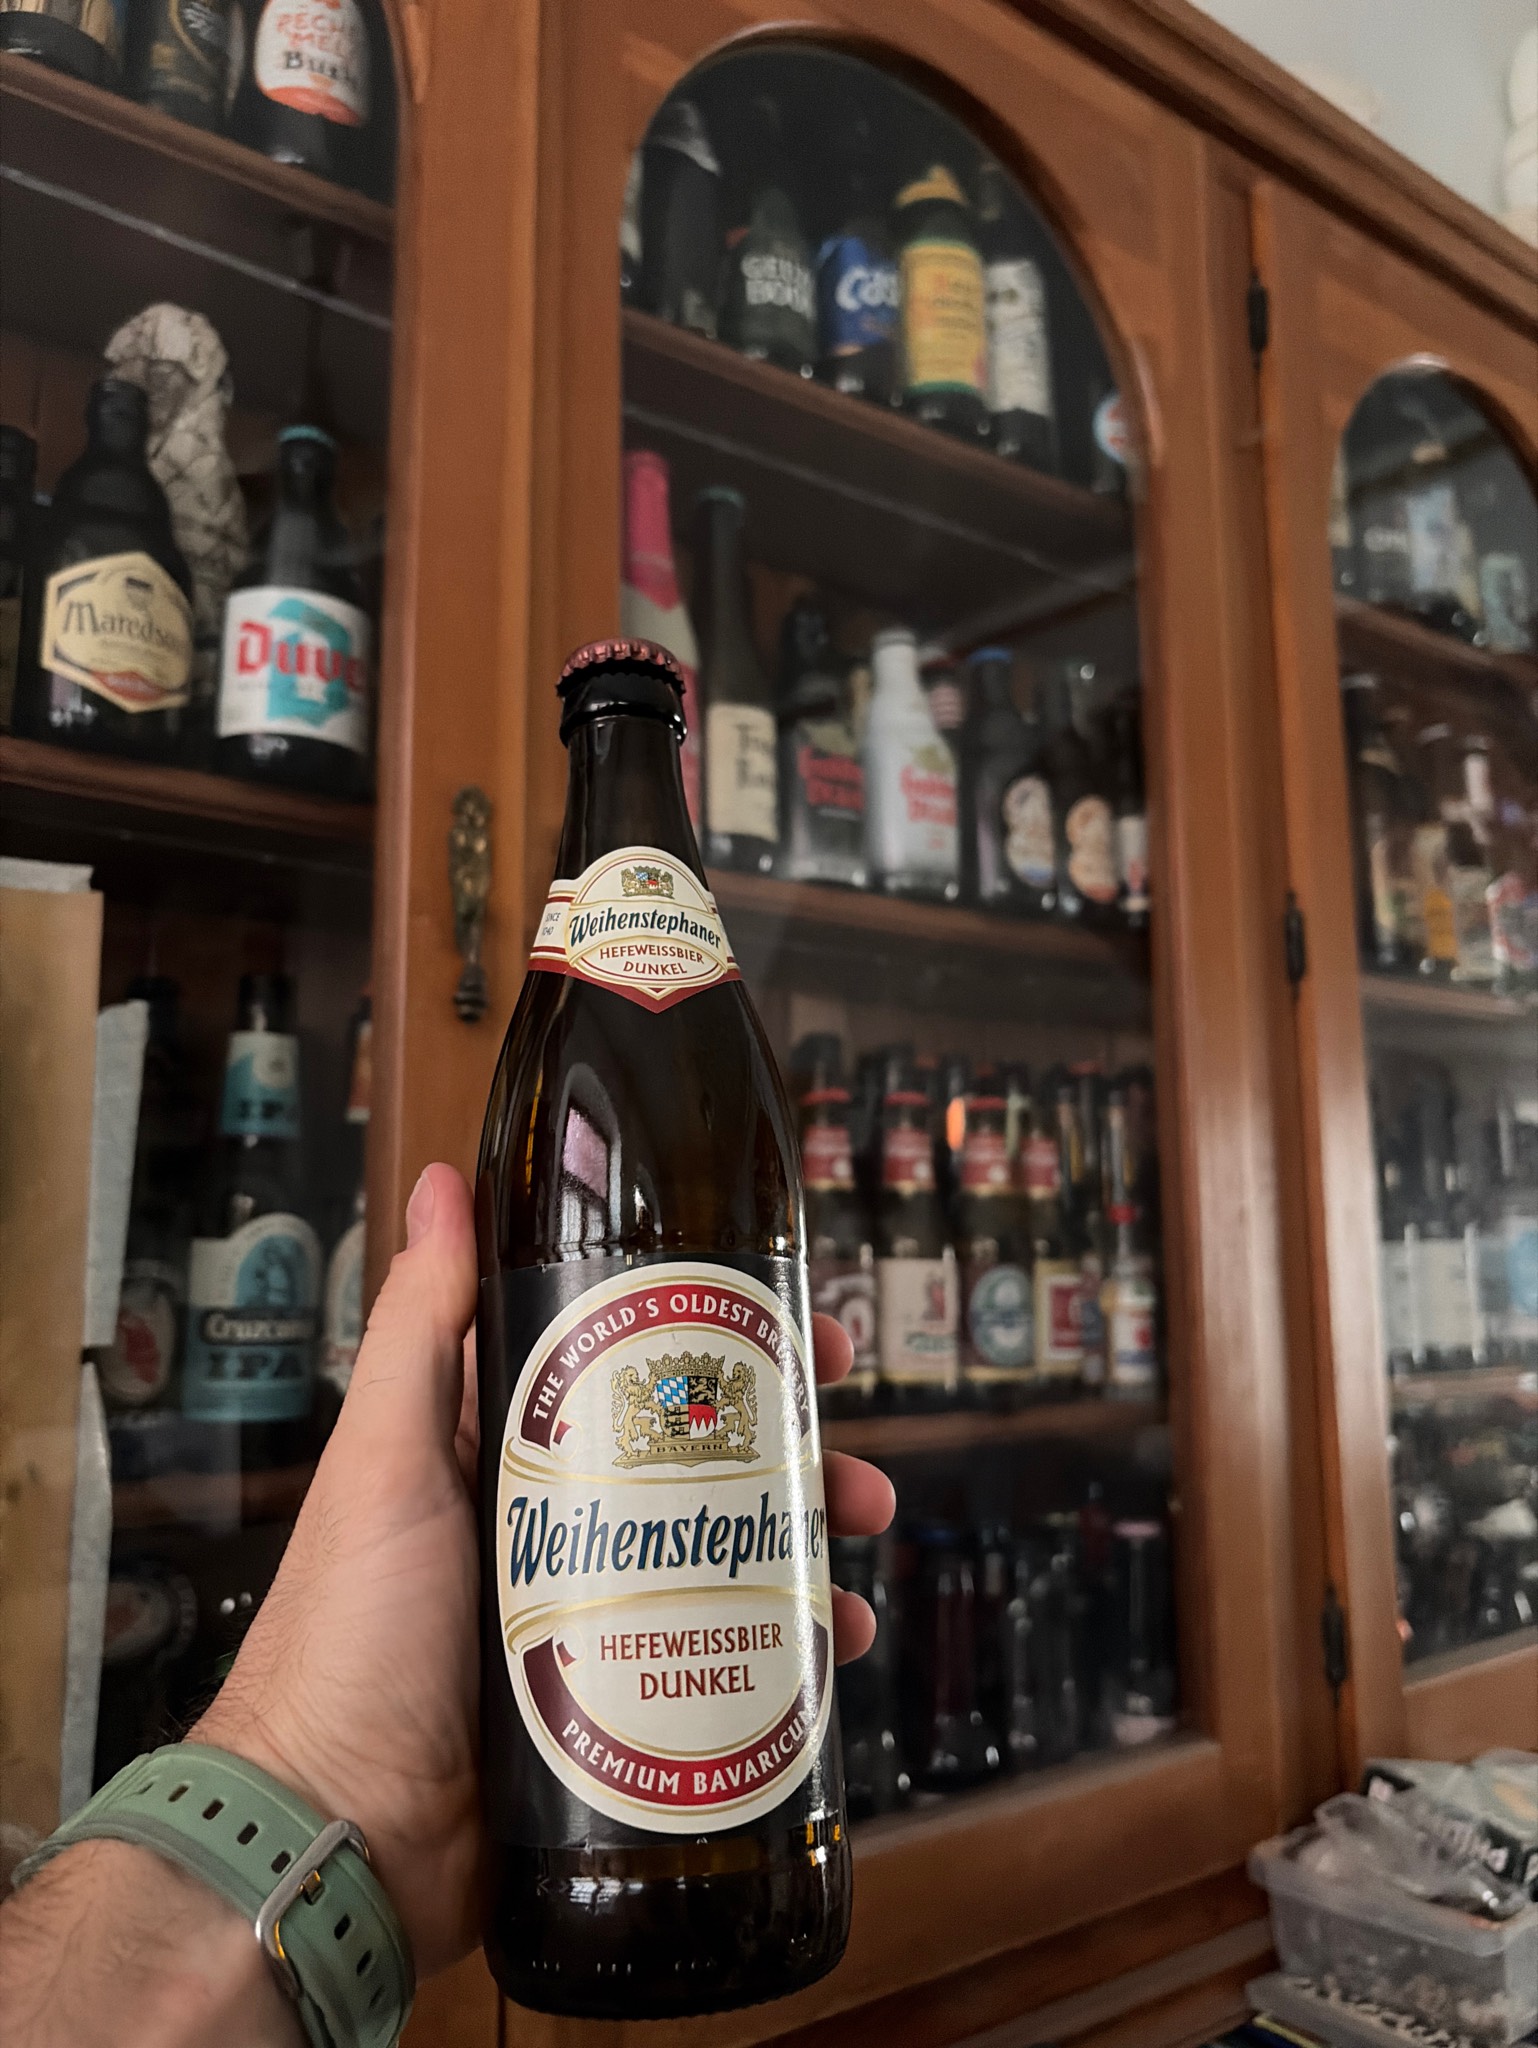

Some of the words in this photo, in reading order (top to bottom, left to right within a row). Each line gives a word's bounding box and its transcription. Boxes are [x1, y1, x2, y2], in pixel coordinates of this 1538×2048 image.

[569, 907, 722, 949] Weihenstephaner
[600, 944, 705, 964] HEFEWEISSBIER
[623, 961, 688, 975] DUNKEL
[533, 1371, 564, 1420] THE
[670, 1294, 754, 1323] OLDEST
[656, 1443, 724, 1454] BAYERN
[600, 1622, 784, 1662] HEFEWEISSBIER
[640, 1664, 756, 1700] DUNKEL
[562, 1718, 680, 1795] PREMIUM
